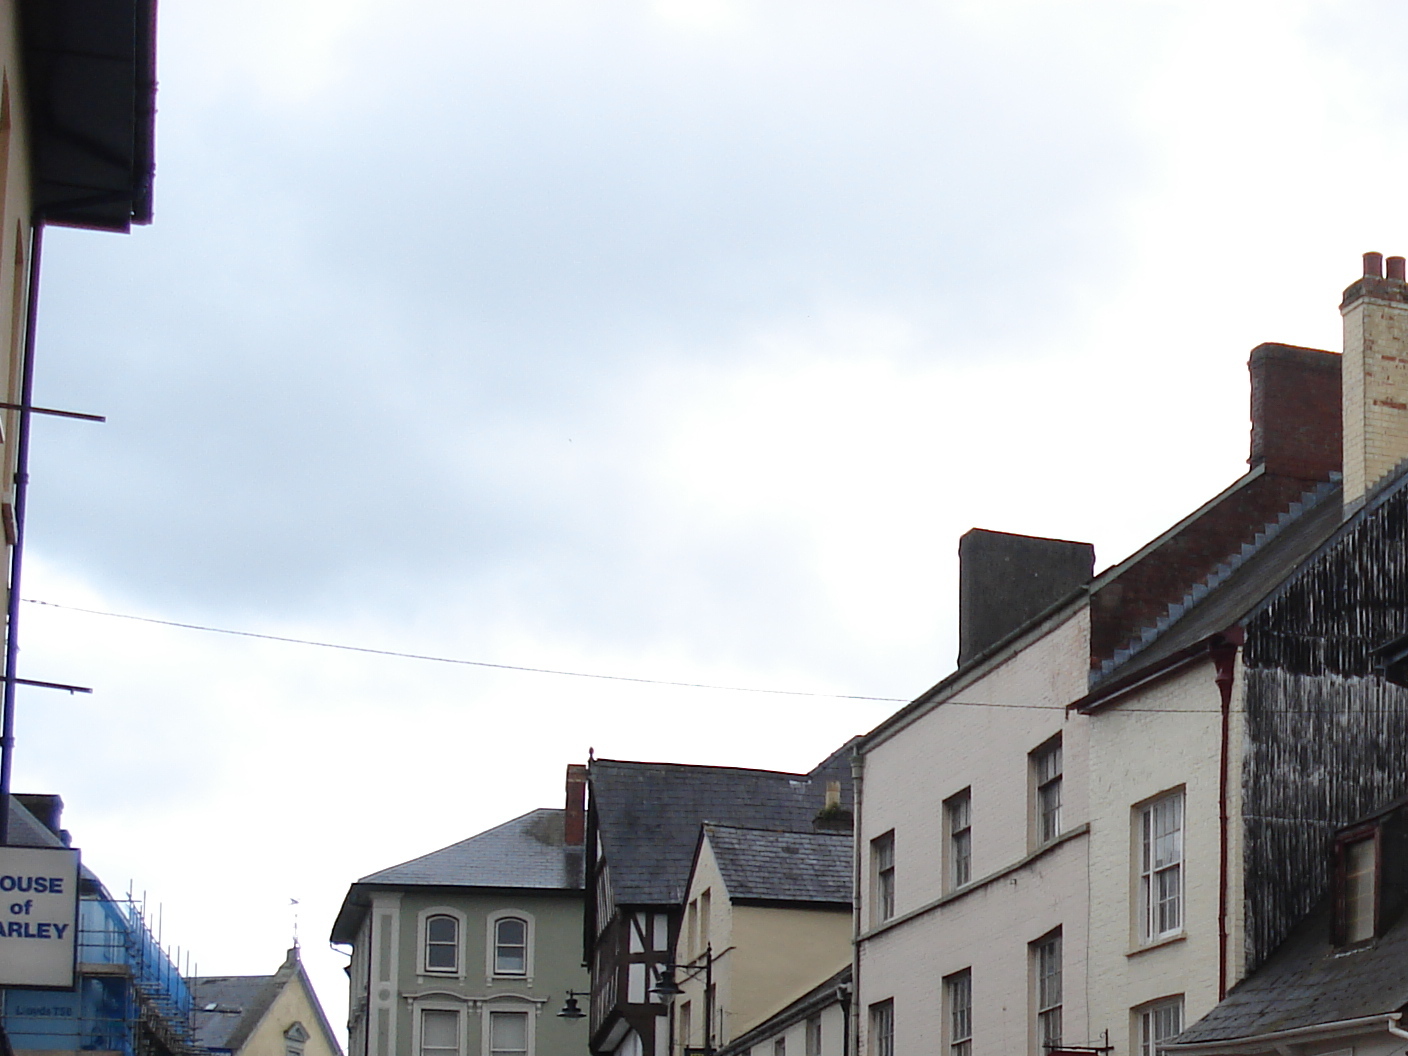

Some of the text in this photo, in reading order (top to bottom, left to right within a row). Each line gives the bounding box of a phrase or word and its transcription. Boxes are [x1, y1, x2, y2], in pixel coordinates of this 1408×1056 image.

[0, 875, 64, 893] OUSE
[10, 899, 33, 915] of
[0, 922, 69, 939] ARLEY
